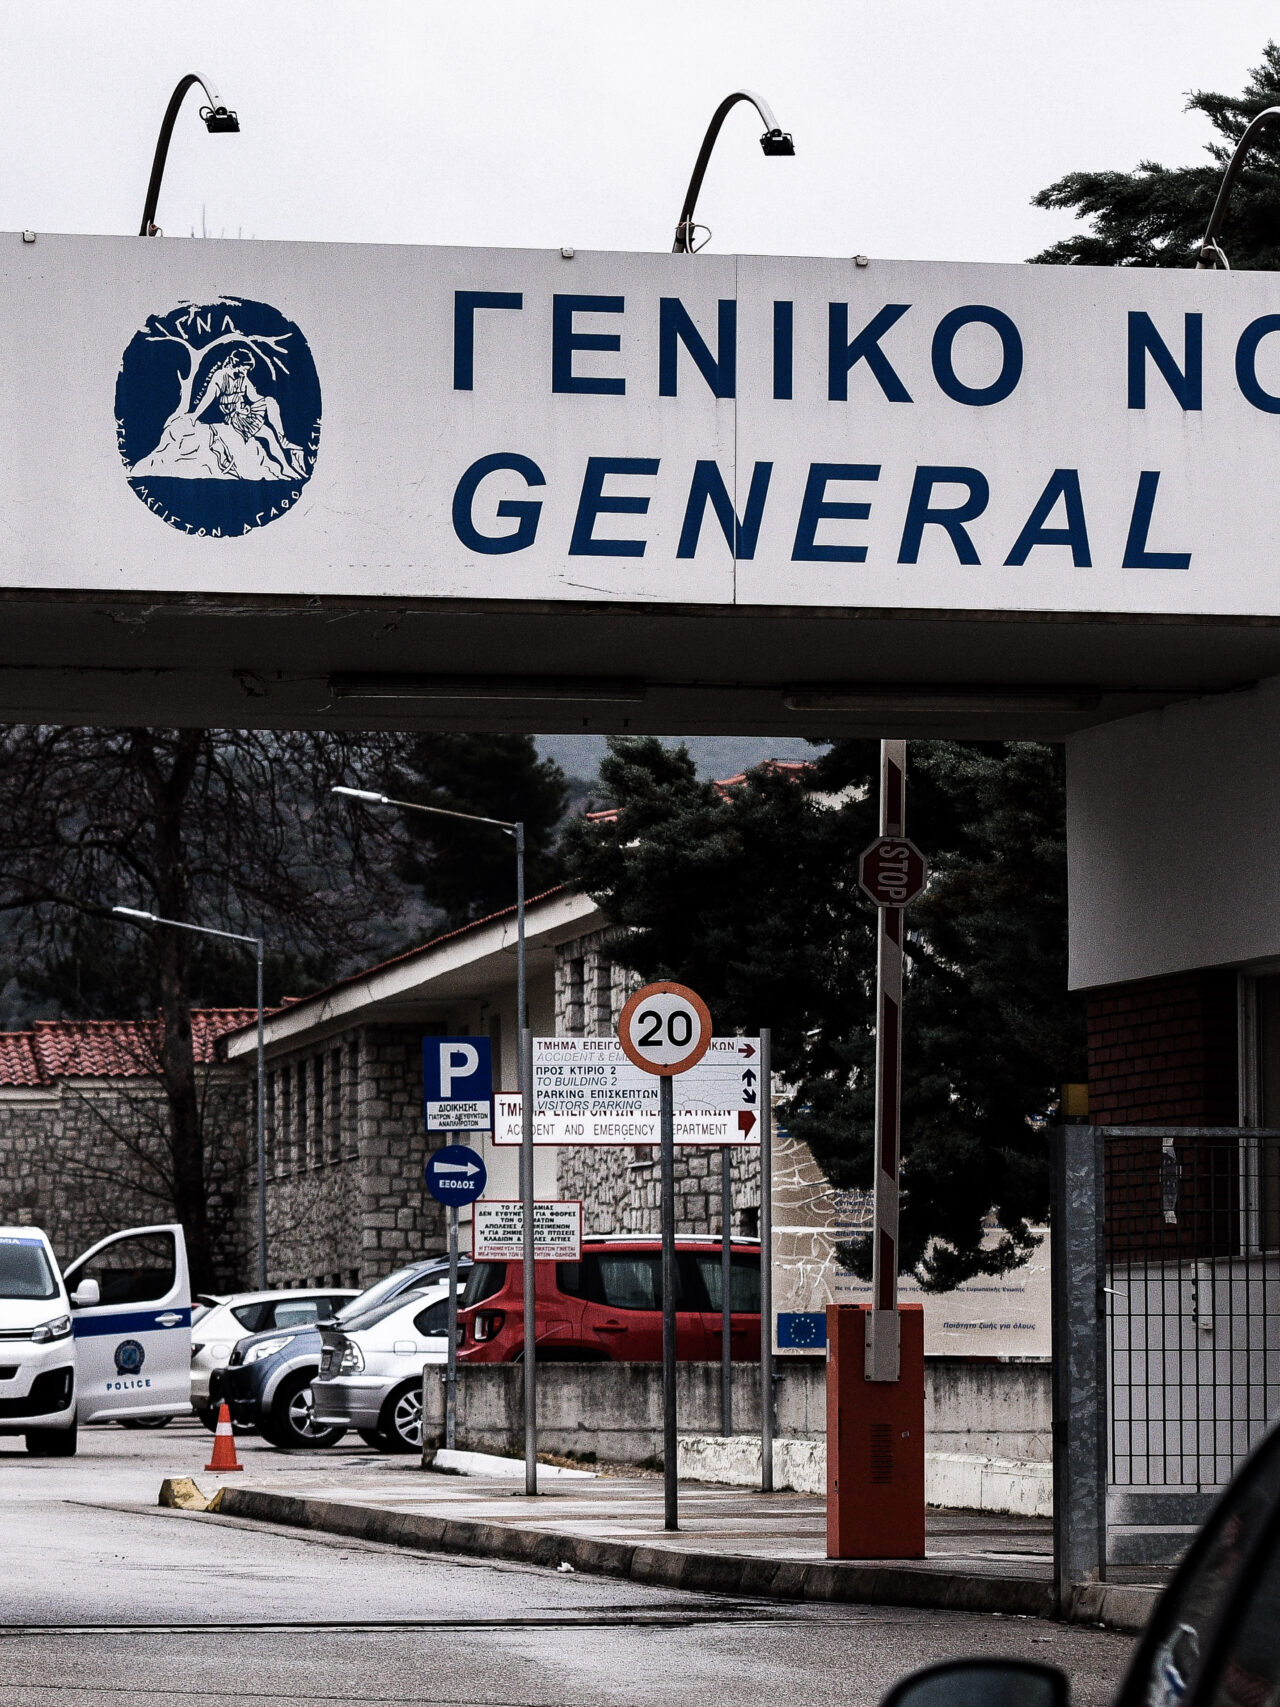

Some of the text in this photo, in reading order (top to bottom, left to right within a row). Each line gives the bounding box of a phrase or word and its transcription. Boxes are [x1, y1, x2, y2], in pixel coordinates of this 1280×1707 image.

[453, 291, 1024, 407] ΓΕΝΙΚΟ
[452, 452, 1193, 571] GENERAL
[877, 846, 910, 900] STOP
[638, 1010, 693, 1047] 20
[537, 1041, 577, 1050] ΤΜΗΜΑ
[536, 1052, 596, 1062] ACCIDENT
[439, 1043, 479, 1097] P
[536, 1066, 616, 1076] ΠΡΟΣ ΚΤΙΡΙΟ 2
[537, 1077, 618, 1086] TO BUILDING 2
[536, 1090, 658, 1099] PARKING ΕΠΙΣΚΕΠΤΩΝ
[438, 1103, 478, 1112] ΔΙΟΙΚΗΣΗΣ
[537, 1100, 642, 1110] VISITORS PARKING
[507, 1124, 556, 1136] ACDENT
[564, 1124, 585, 1136] AND
[593, 1124, 655, 1136] EMERGENCY
[439, 1180, 475, 1189] ΕΞΟΔΟΣ
[106, 1379, 151, 1391] POLICE
